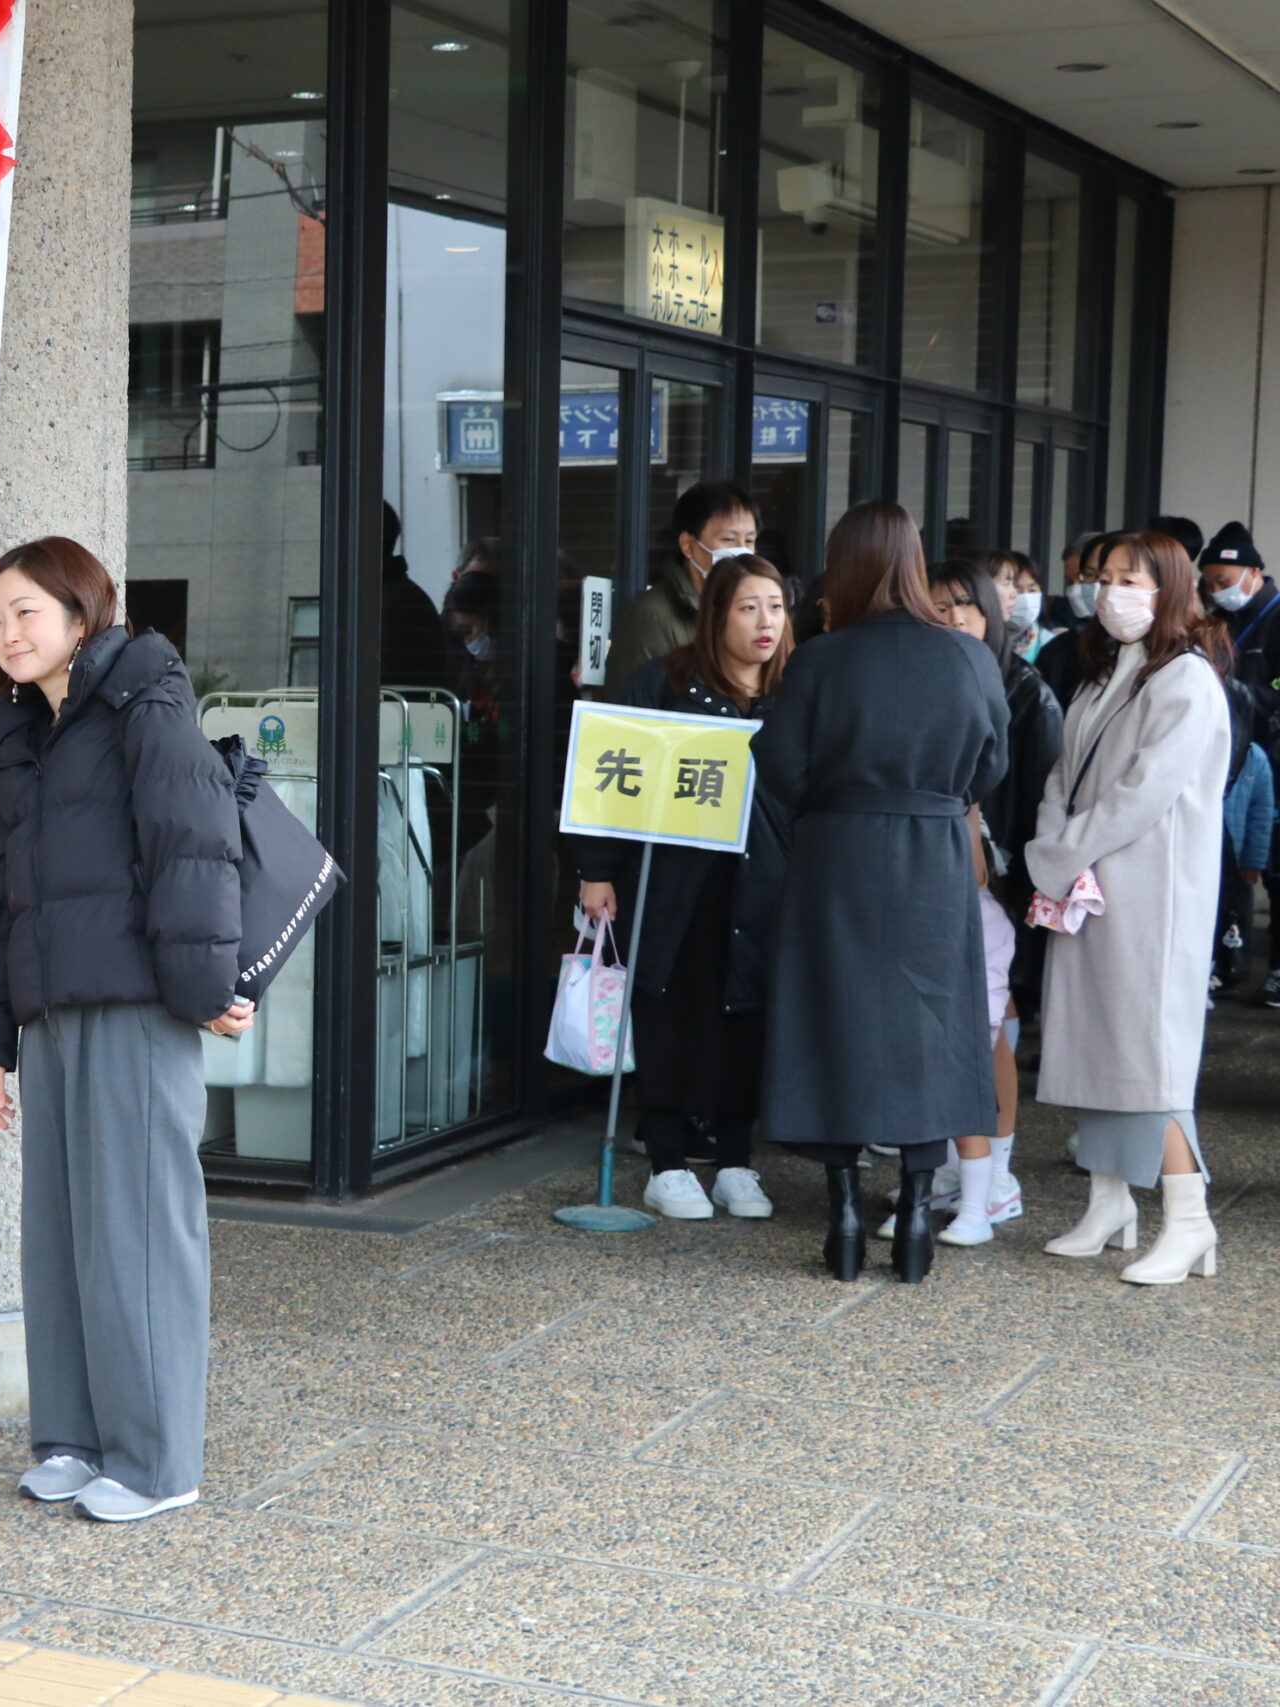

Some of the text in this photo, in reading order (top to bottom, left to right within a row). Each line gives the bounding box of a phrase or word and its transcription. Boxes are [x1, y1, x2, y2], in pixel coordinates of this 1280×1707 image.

[652, 221, 710, 265] 大ホール
[652, 256, 710, 296] 小ホール
[651, 289, 723, 330] ポルティコホー
[589, 591, 604, 669] 閉切
[595, 748, 727, 808] 先頭
[241, 947, 276, 982] START
[275, 941, 283, 952] A
[281, 918, 297, 942] DAY
[295, 890, 316, 921] WITH
[314, 881, 322, 893] A
